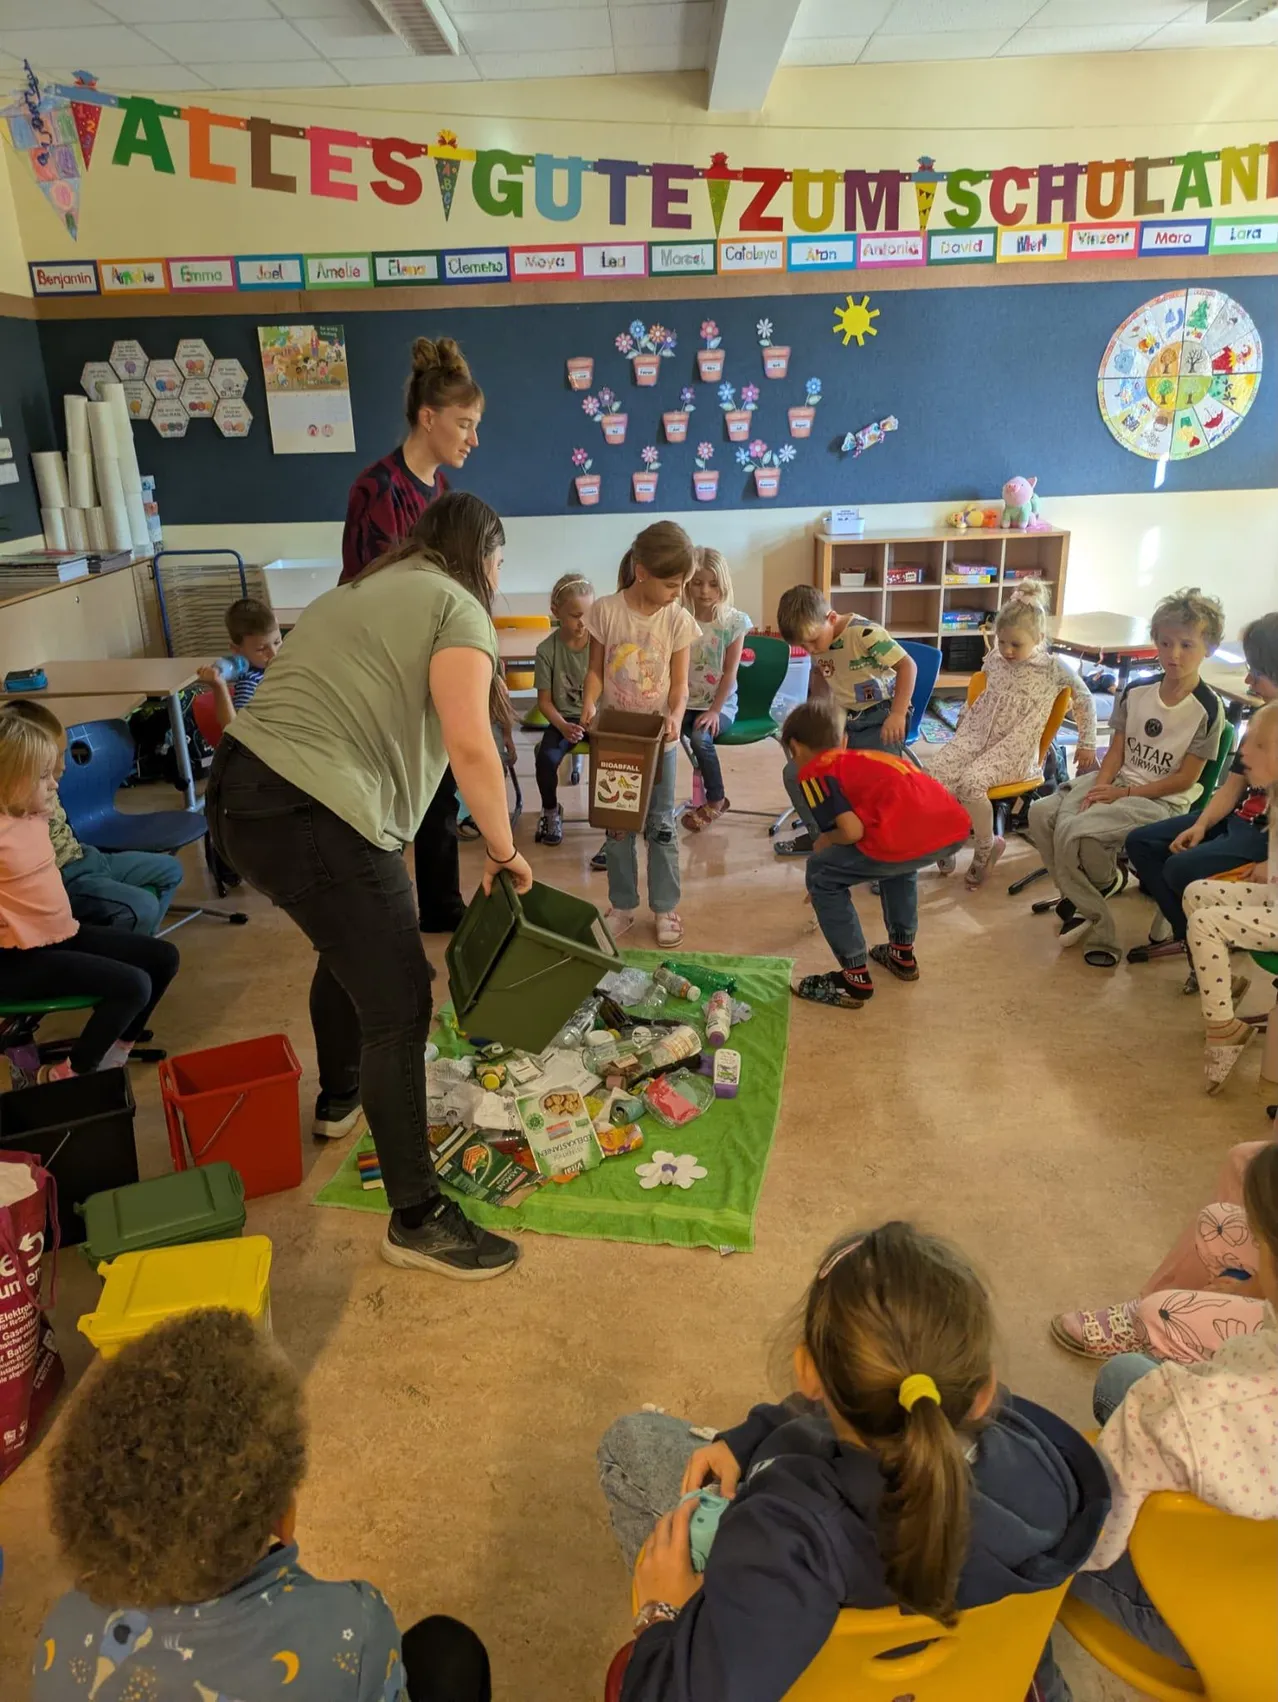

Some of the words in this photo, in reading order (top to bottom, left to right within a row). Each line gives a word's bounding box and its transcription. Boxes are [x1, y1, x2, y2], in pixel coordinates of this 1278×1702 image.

[111, 96, 423, 206] ALLES
[472, 149, 693, 230] GUTE
[739, 167, 900, 233] ZUM
[1077, 230, 1129, 246] Vinzent
[1155, 231, 1192, 245] Mara
[1230, 227, 1262, 241] Lara
[863, 240, 919, 257] Antonia
[941, 239, 983, 254] David
[600, 251, 626, 269] Lea
[661, 247, 706, 267] Marcel
[37, 269, 92, 290] Benjamin
[180, 265, 222, 284] Emma
[317, 261, 360, 280] Amelie
[601, 761, 640, 772] BIOABFALL
[1130, 755, 1171, 776] AIRWAYS
[536, 1134, 593, 1158] EDELKASTANIEN
[564, 1162, 584, 1176] Vital
[496, 1166, 523, 1191] LASAGNE
